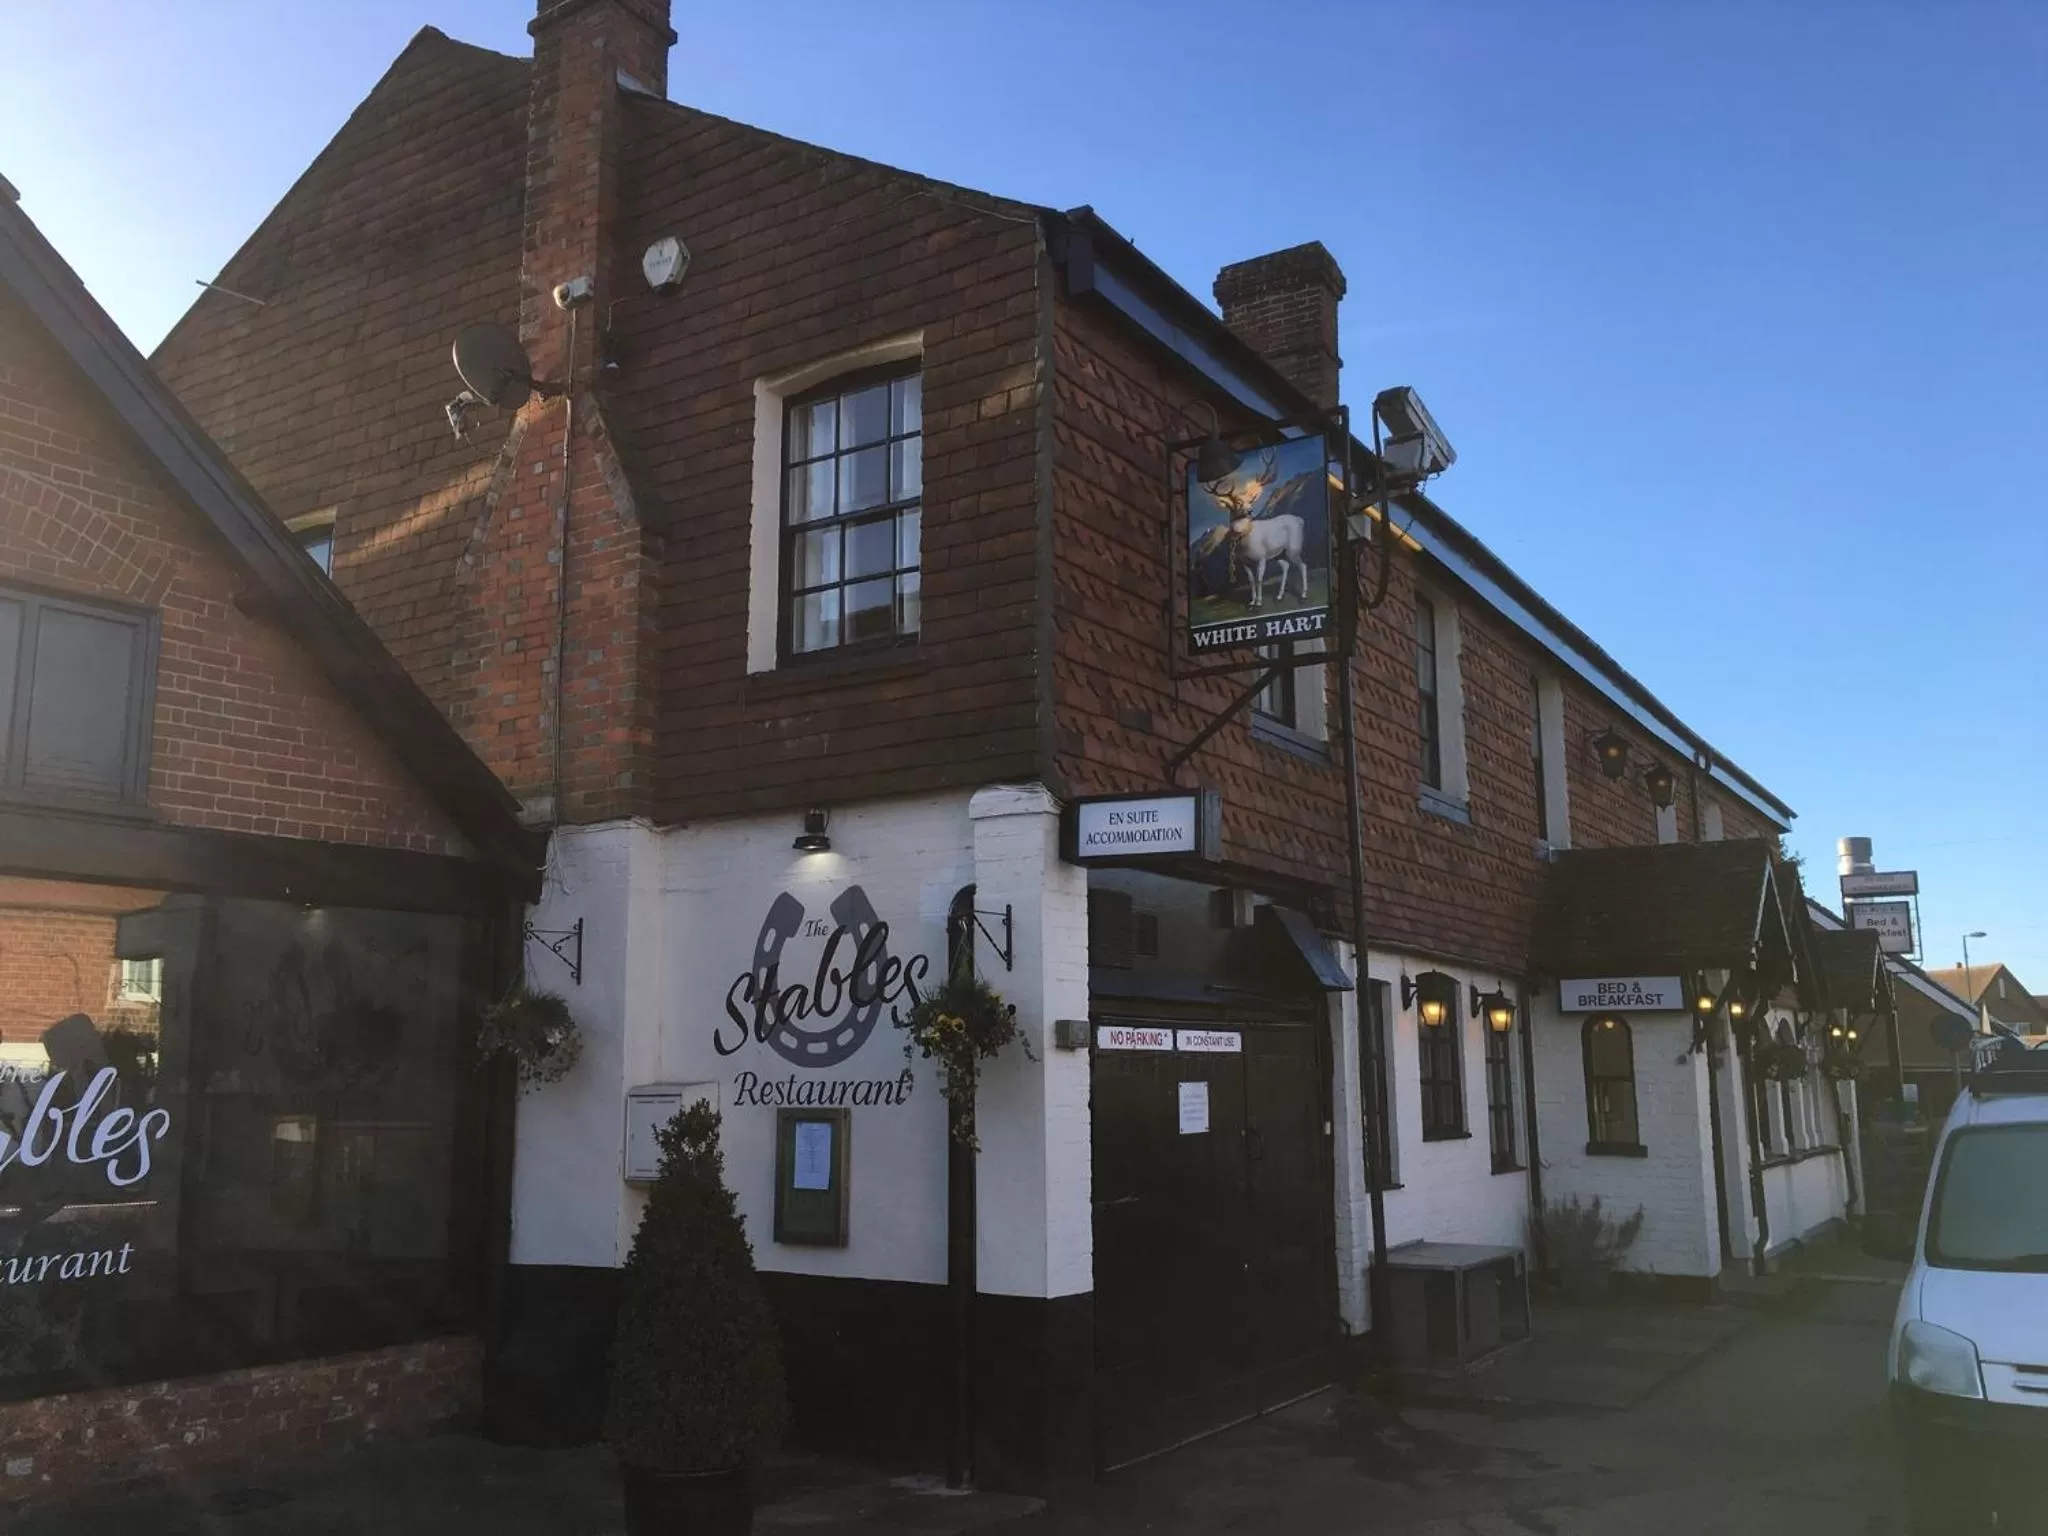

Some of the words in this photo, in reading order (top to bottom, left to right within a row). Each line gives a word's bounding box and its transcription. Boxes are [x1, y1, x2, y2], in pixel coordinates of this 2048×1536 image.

[1193, 623, 1258, 648] WHITE
[1266, 613, 1327, 637] HART
[1108, 812, 1124, 825] EN
[1127, 810, 1159, 825] SUITE
[1085, 827, 1183, 845] ACCOMMODATION
[804, 920, 829, 938] The
[713, 921, 929, 1056] Stables
[1597, 982, 1627, 995] BED
[1631, 981, 1642, 994] &
[1577, 993, 1665, 1007] BREAKFAST
[1110, 1031, 1124, 1045] NO
[1125, 1031, 1163, 1046] PARKING
[733, 1071, 907, 1106] Restaurant
[0, 1066, 170, 1186] bles
[0, 1242, 135, 1284] urant
